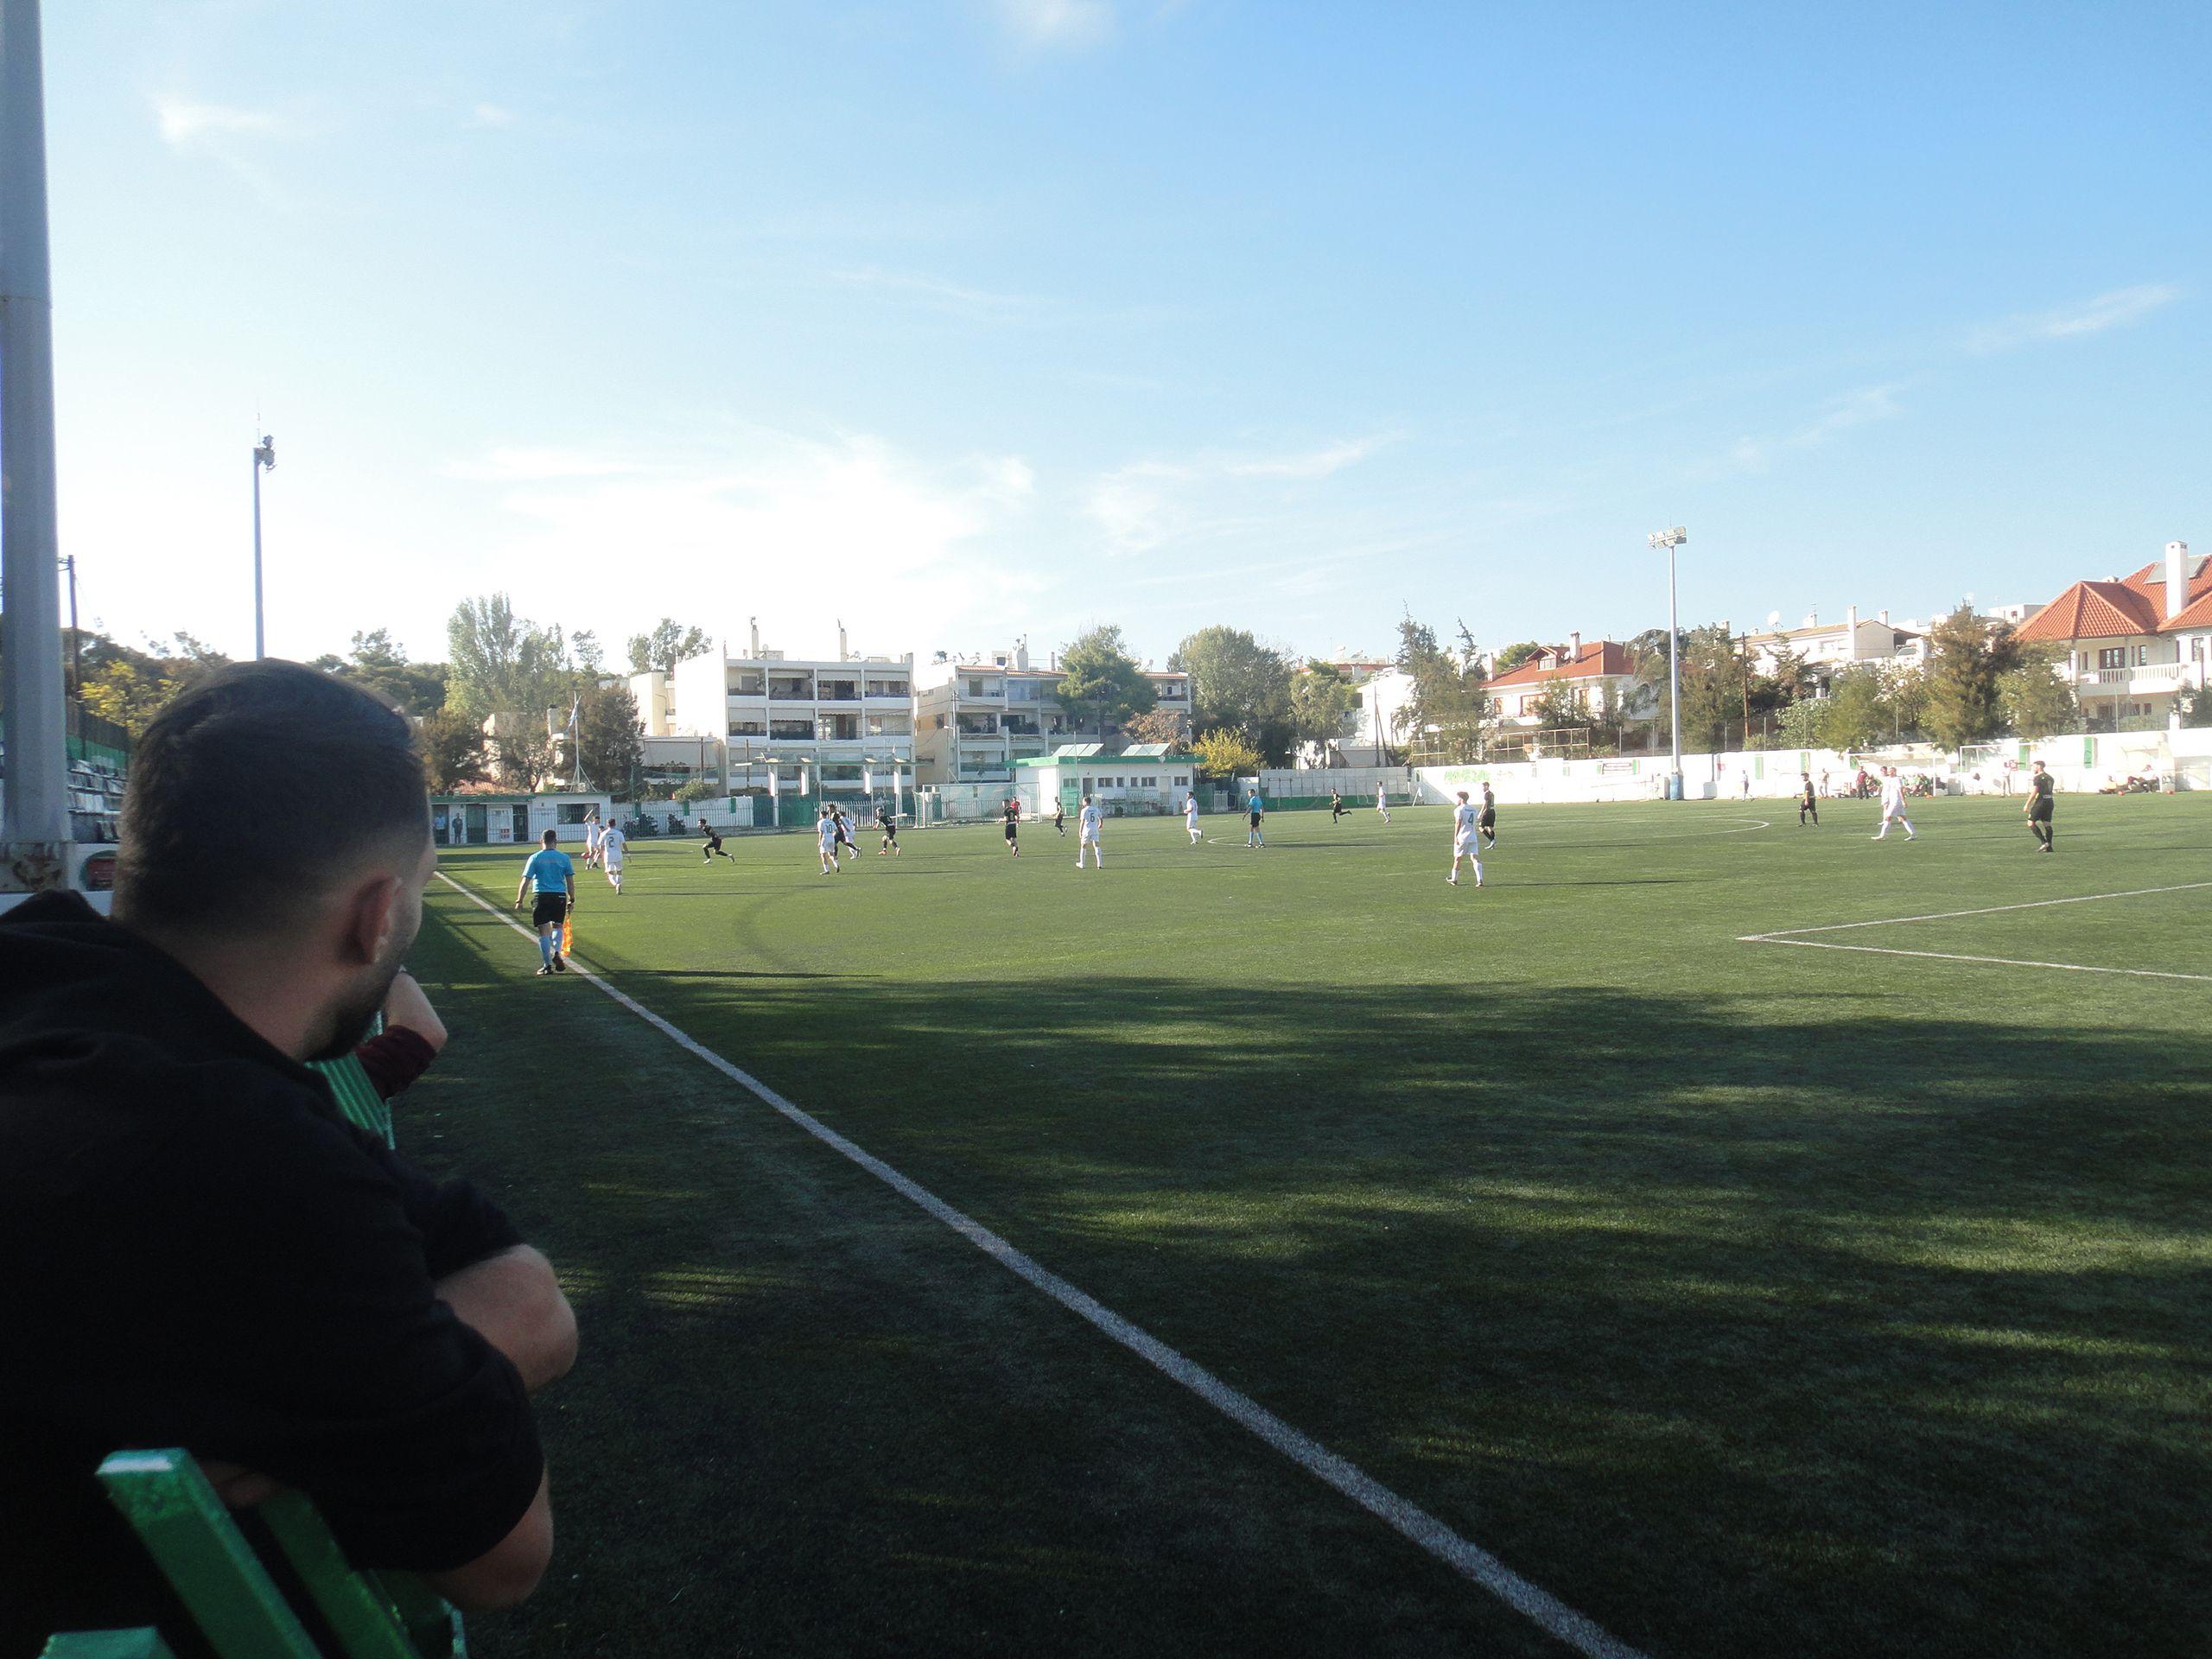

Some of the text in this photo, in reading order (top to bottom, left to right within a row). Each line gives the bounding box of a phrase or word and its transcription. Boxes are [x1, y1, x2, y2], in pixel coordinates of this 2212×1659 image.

[1090, 812, 1096, 822] 6
[1467, 812, 1474, 825] 4
[608, 836, 614, 848] 2
